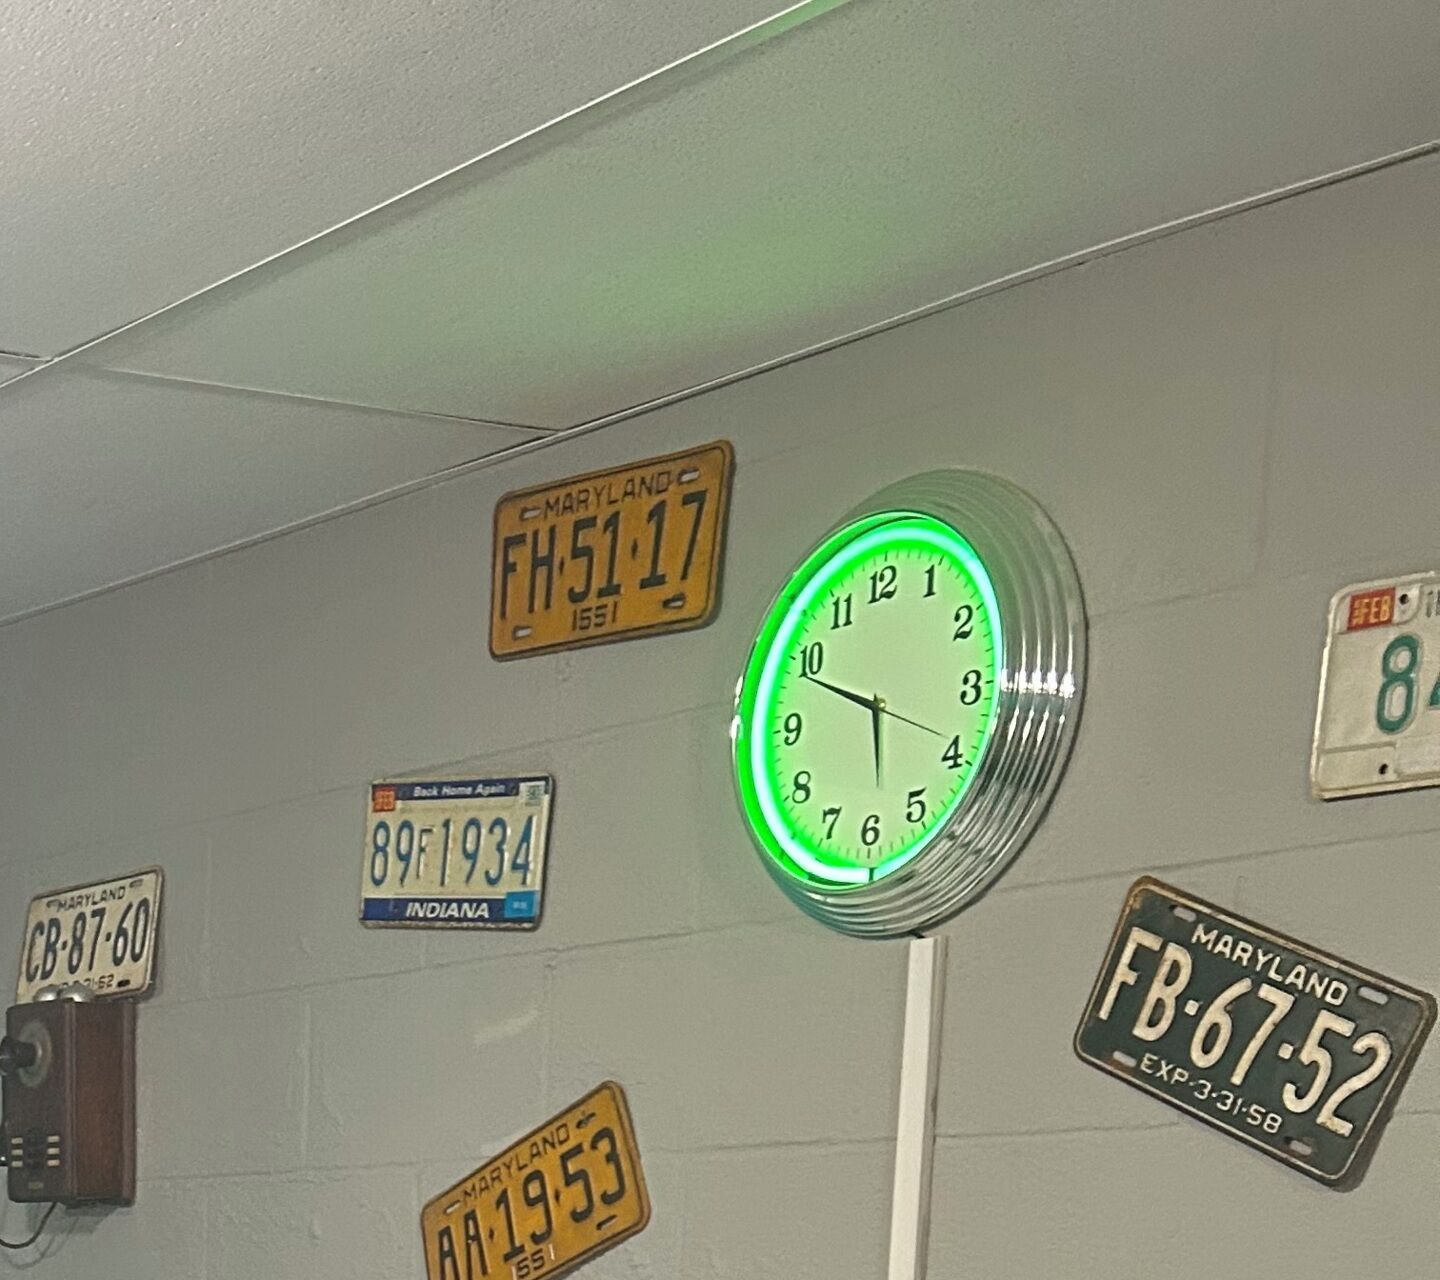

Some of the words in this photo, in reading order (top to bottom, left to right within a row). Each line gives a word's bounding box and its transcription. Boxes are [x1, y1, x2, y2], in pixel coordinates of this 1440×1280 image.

[544, 472, 672, 518] MARYLAND
[868, 565, 898, 604] 12
[923, 564, 936, 598] 1
[830, 594, 853, 630] 11
[953, 604, 974, 642] 2
[1360, 595, 1391, 625] FEB
[799, 642, 823, 679] 10
[960, 670, 982, 705] 3
[783, 713, 802, 746] 9
[941, 735, 964, 770] 4
[413, 786, 439, 798] Back
[442, 784, 473, 796] Home
[476, 782, 506, 797] Again
[791, 771, 811, 804] 8
[822, 806, 842, 840] 7
[906, 788, 927, 823] 5
[861, 815, 881, 847] 6
[370, 814, 535, 887] 89F1934
[58, 886, 126, 912] MARYLAND
[405, 902, 490, 919] INDIANA
[1191, 923, 1349, 1007] MARYLAND
[462, 1123, 571, 1206] MARYLAND
